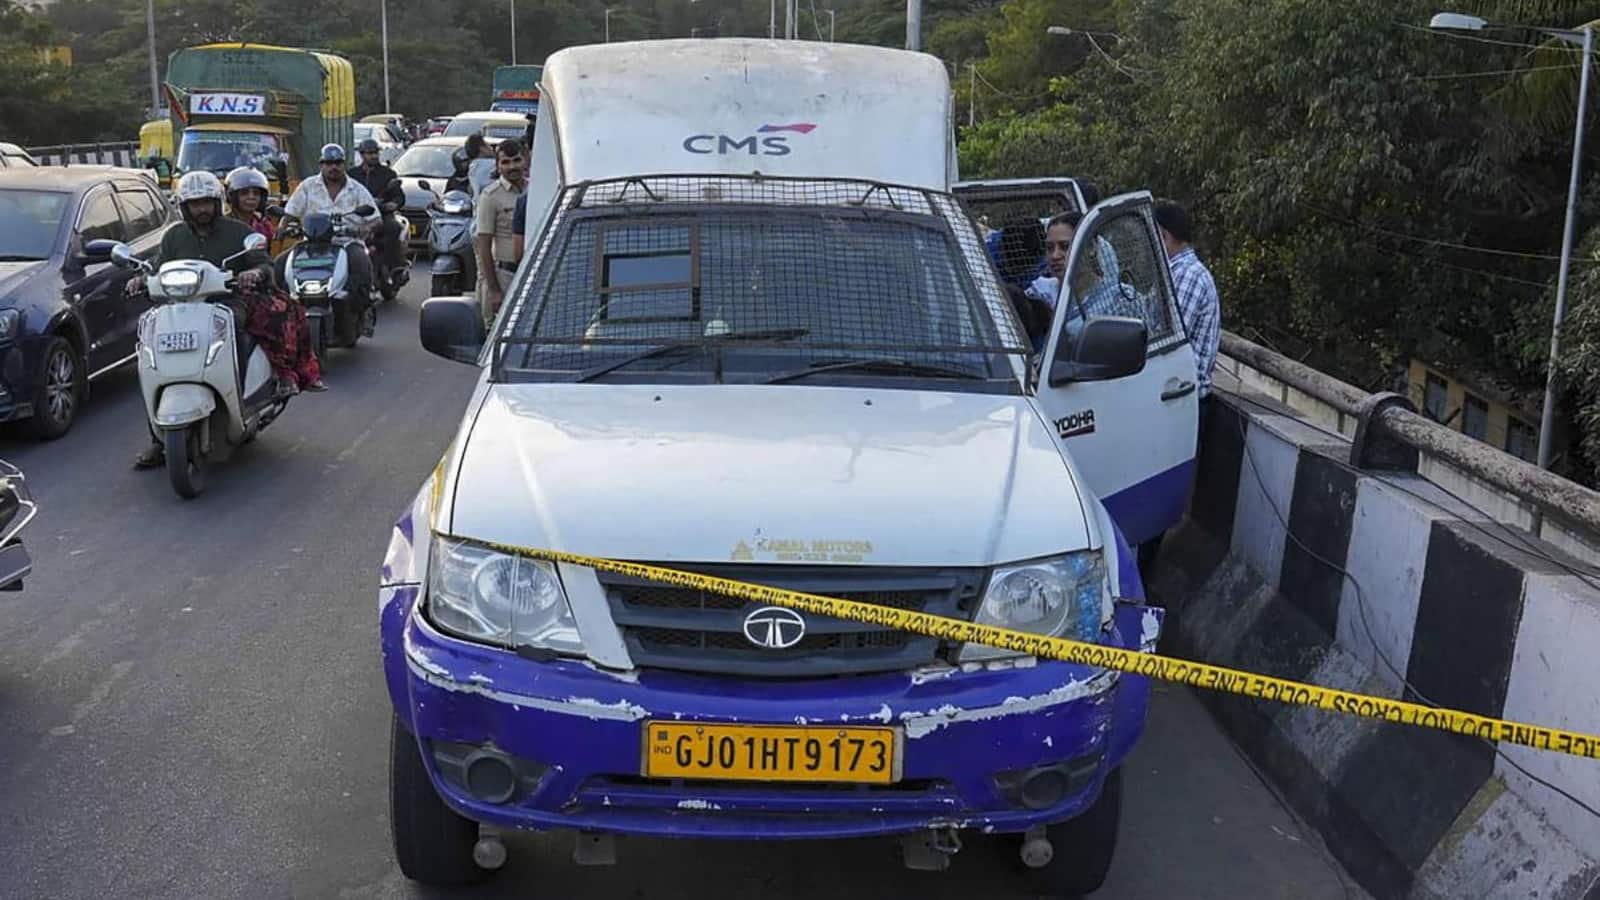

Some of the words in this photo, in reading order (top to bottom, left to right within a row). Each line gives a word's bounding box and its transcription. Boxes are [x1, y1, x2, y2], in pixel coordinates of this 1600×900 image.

[198, 96, 258, 112] K.N.S
[683, 135, 791, 156] CMS
[1052, 409, 1095, 432] YODHA
[966, 625, 999, 648] LINE
[1067, 643, 1128, 671] CROSS
[1173, 663, 1201, 685] DO
[1206, 669, 1247, 694] LINE
[1254, 678, 1323, 708] POLICE
[1333, 693, 1402, 722] CROSS
[1460, 716, 1492, 739] DO
[1501, 724, 1549, 749] LINE
[654, 745, 672, 755] IND
[676, 735, 886, 772] GJ01HT9173
[1558, 733, 1600, 758] ICE
